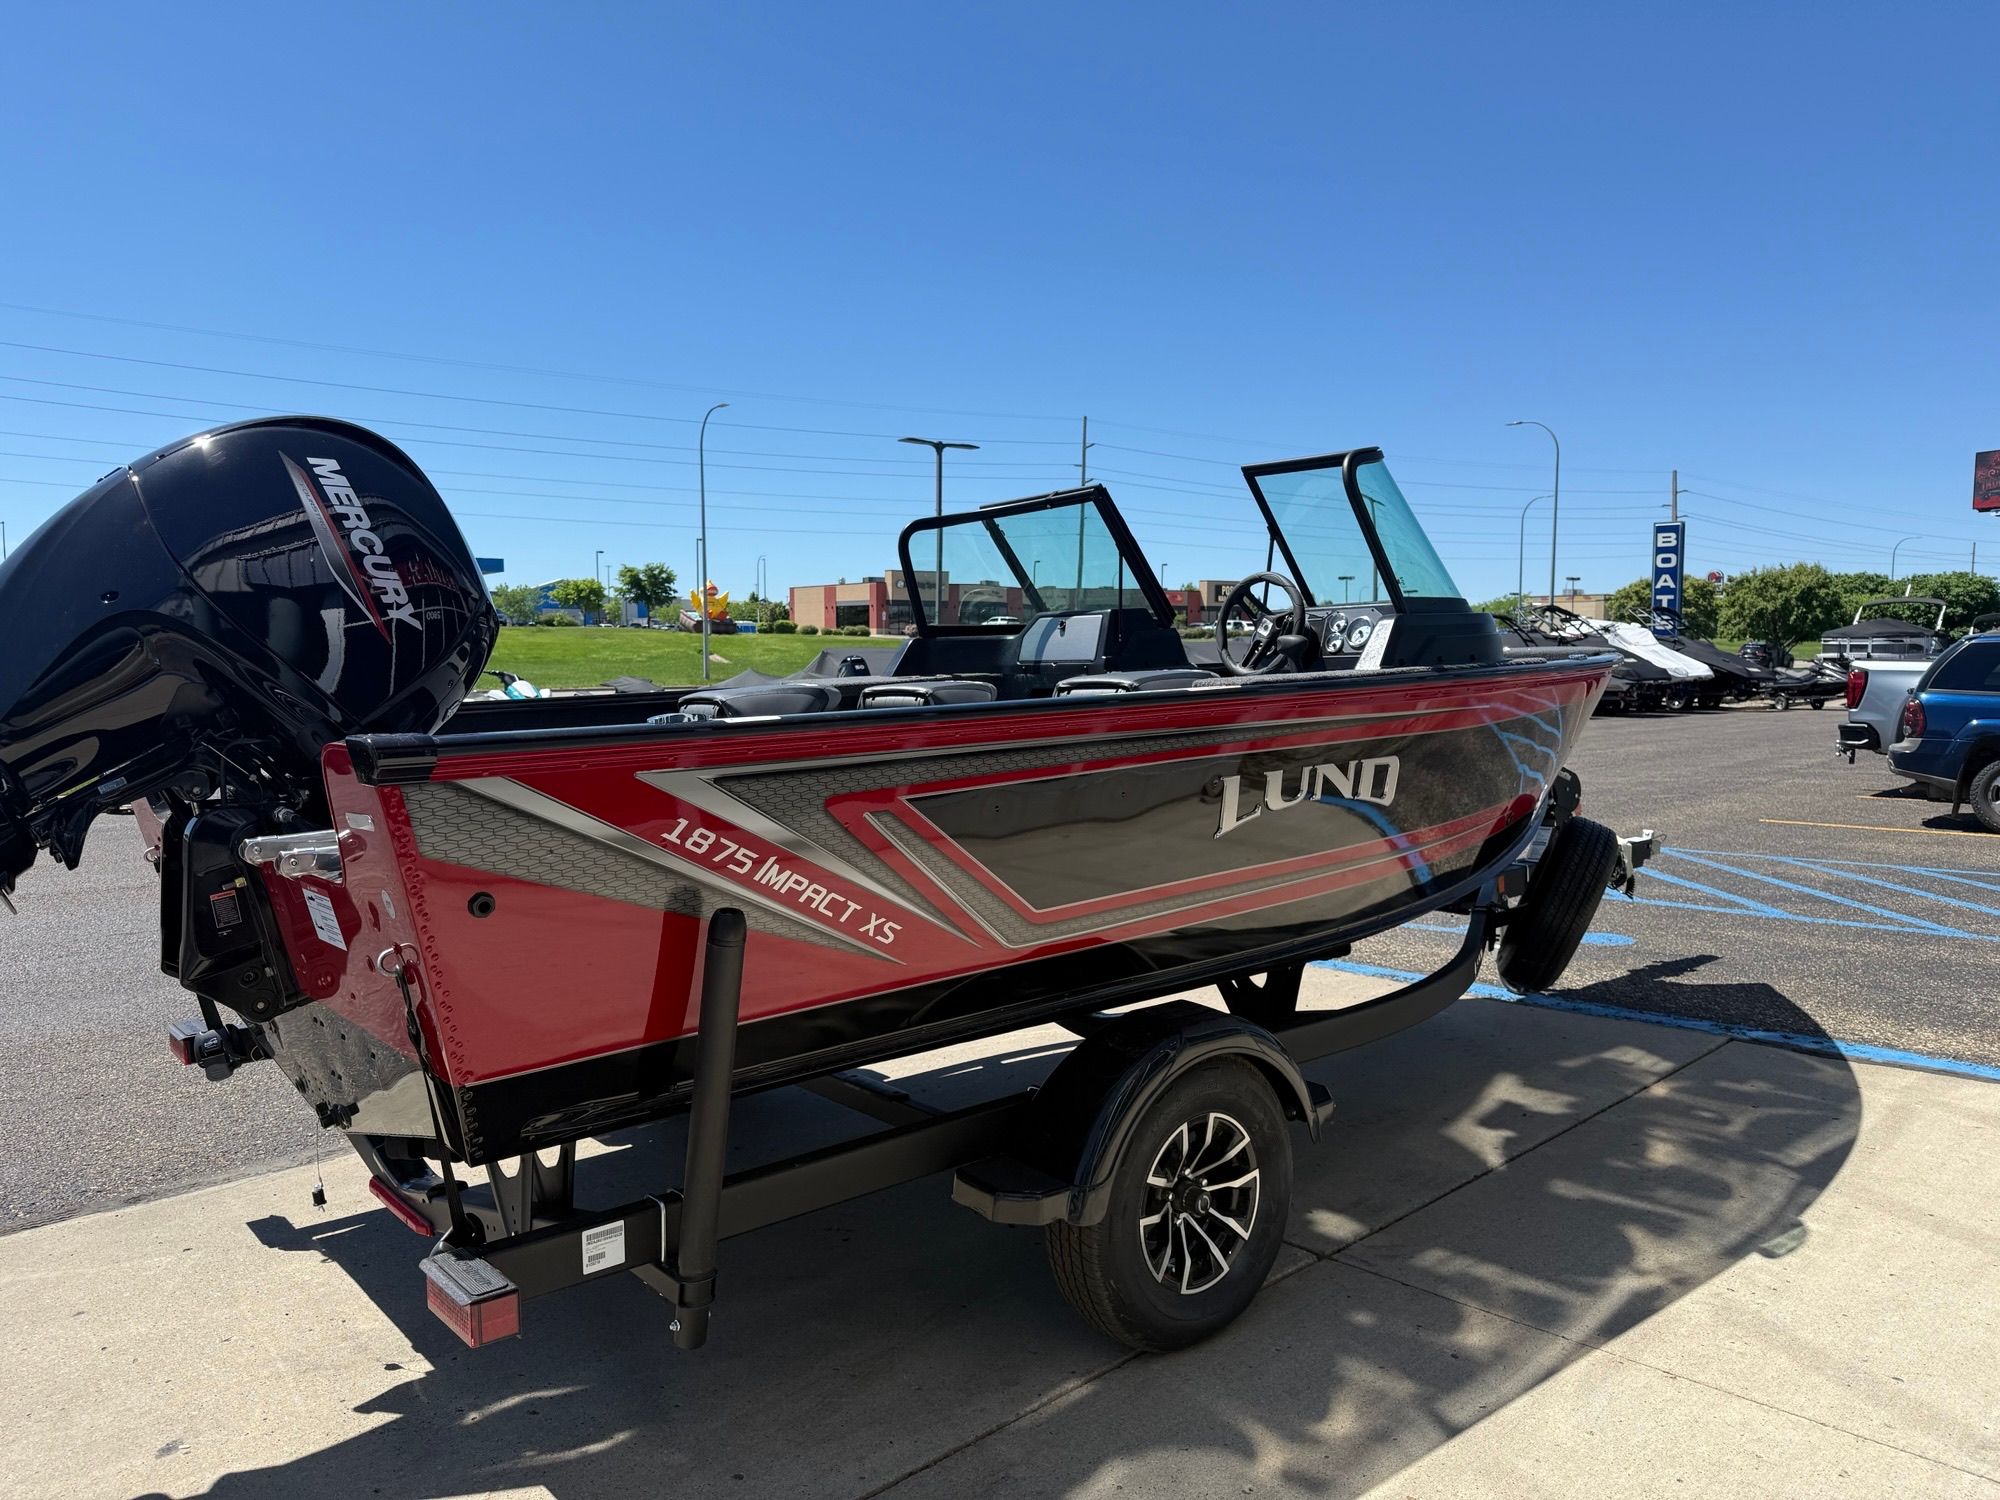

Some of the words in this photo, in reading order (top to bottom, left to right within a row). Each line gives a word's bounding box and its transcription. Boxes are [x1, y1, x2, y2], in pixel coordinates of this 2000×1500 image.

[306, 457, 423, 631] MERCURY
[1655, 532, 1678, 630] BOATS
[1213, 755, 1400, 840] LUND
[660, 817, 759, 874] 1875
[753, 855, 863, 923] IMPACT
[858, 912, 903, 945] XS
